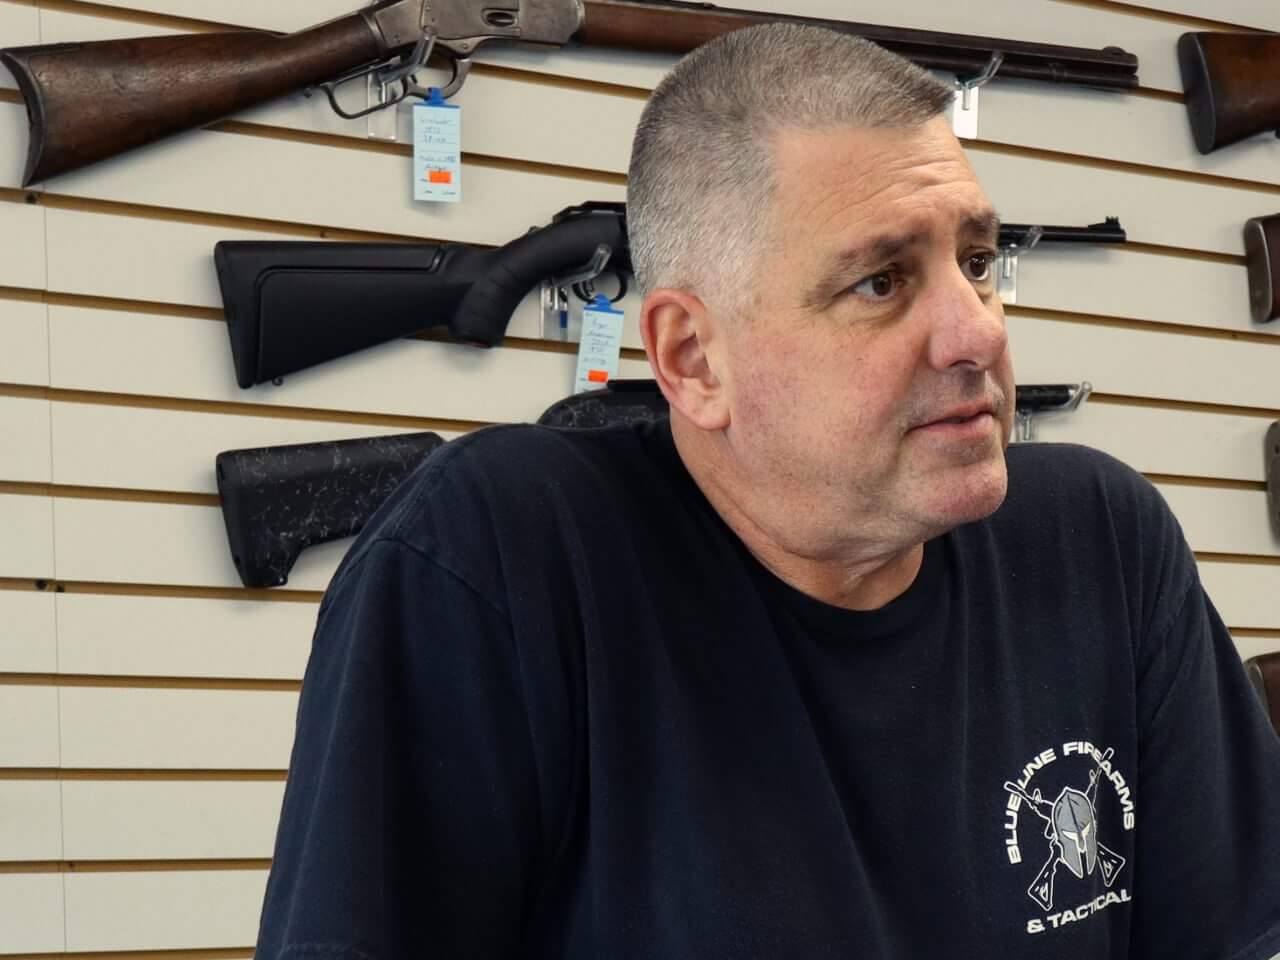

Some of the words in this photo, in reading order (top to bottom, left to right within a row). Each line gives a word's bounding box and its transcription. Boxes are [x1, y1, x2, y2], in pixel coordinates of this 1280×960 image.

[1004, 793, 1022, 864] BLUE
[1017, 748, 1057, 789] LINE
[1062, 741, 1135, 830] FIREARMS
[1047, 889, 1132, 928] TACTICAL
